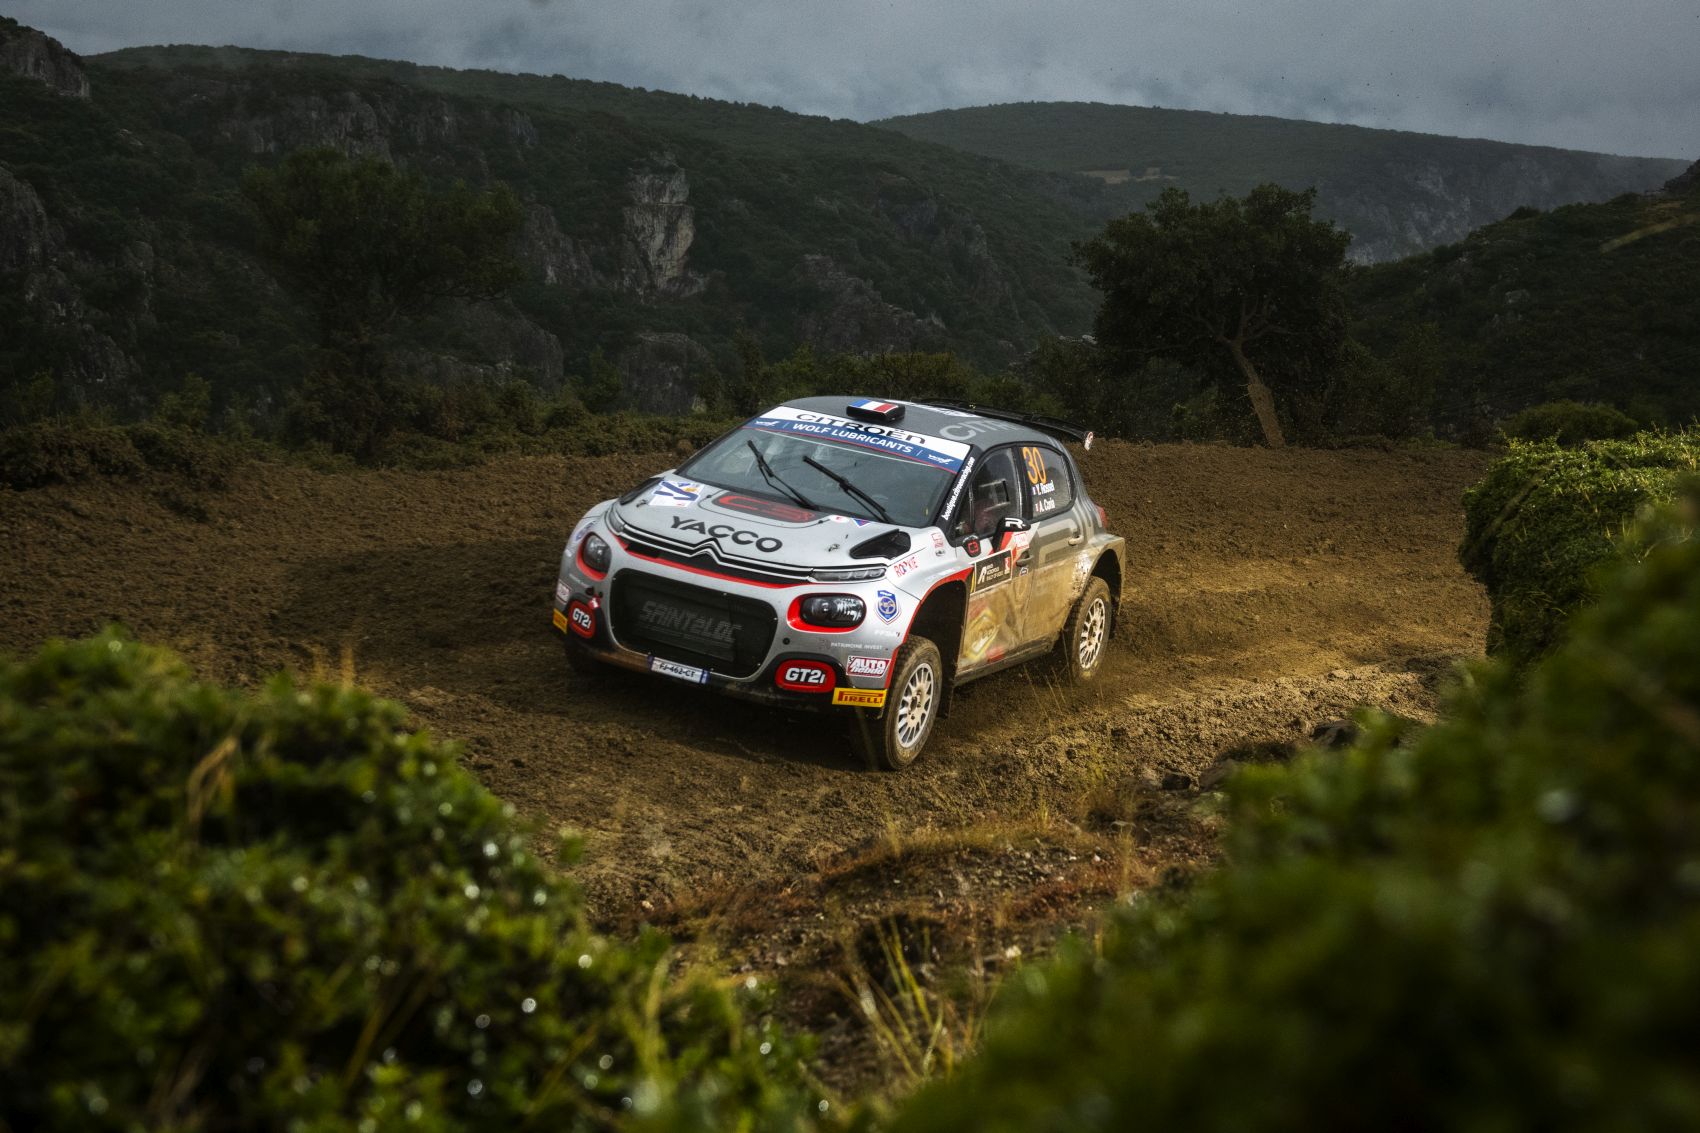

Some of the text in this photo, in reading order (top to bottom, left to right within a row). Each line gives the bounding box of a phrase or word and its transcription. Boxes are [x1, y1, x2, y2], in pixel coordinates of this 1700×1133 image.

[793, 423, 831, 434] WOLF
[832, 428, 914, 453] LUBRICANTS
[1023, 446, 1047, 484] 30
[670, 515, 783, 552] YACCO
[850, 658, 887, 670] AUTO
[838, 690, 883, 704] PIRELLI
